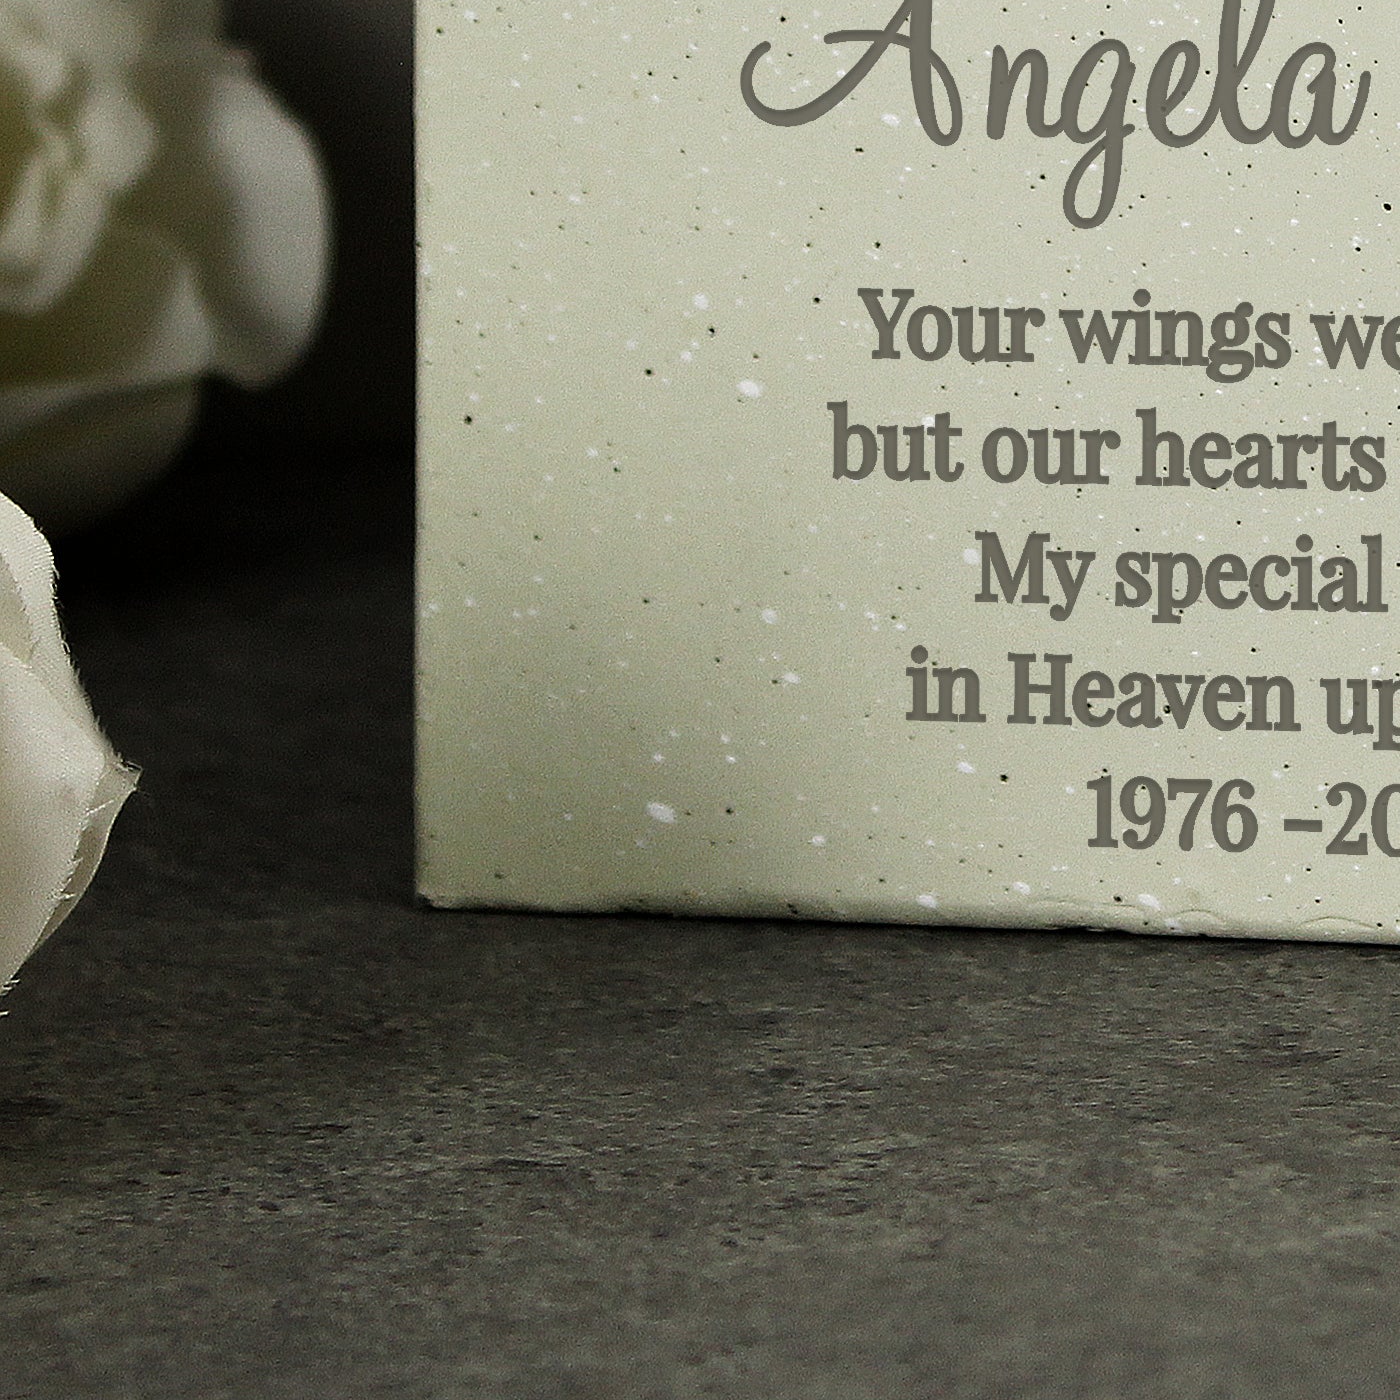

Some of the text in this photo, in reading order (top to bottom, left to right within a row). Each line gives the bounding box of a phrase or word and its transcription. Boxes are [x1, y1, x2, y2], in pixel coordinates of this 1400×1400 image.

[858, 288, 1045, 364] Your
[1059, 289, 1291, 383] wings
[827, 401, 964, 482] but
[981, 416, 1120, 485] our
[1136, 408, 1386, 492] hearts
[975, 531, 1096, 621] My
[1115, 534, 1388, 624] special
[906, 645, 986, 723] in
[1007, 652, 1301, 731] Heaven
[1087, 776, 1258, 852] 1976
